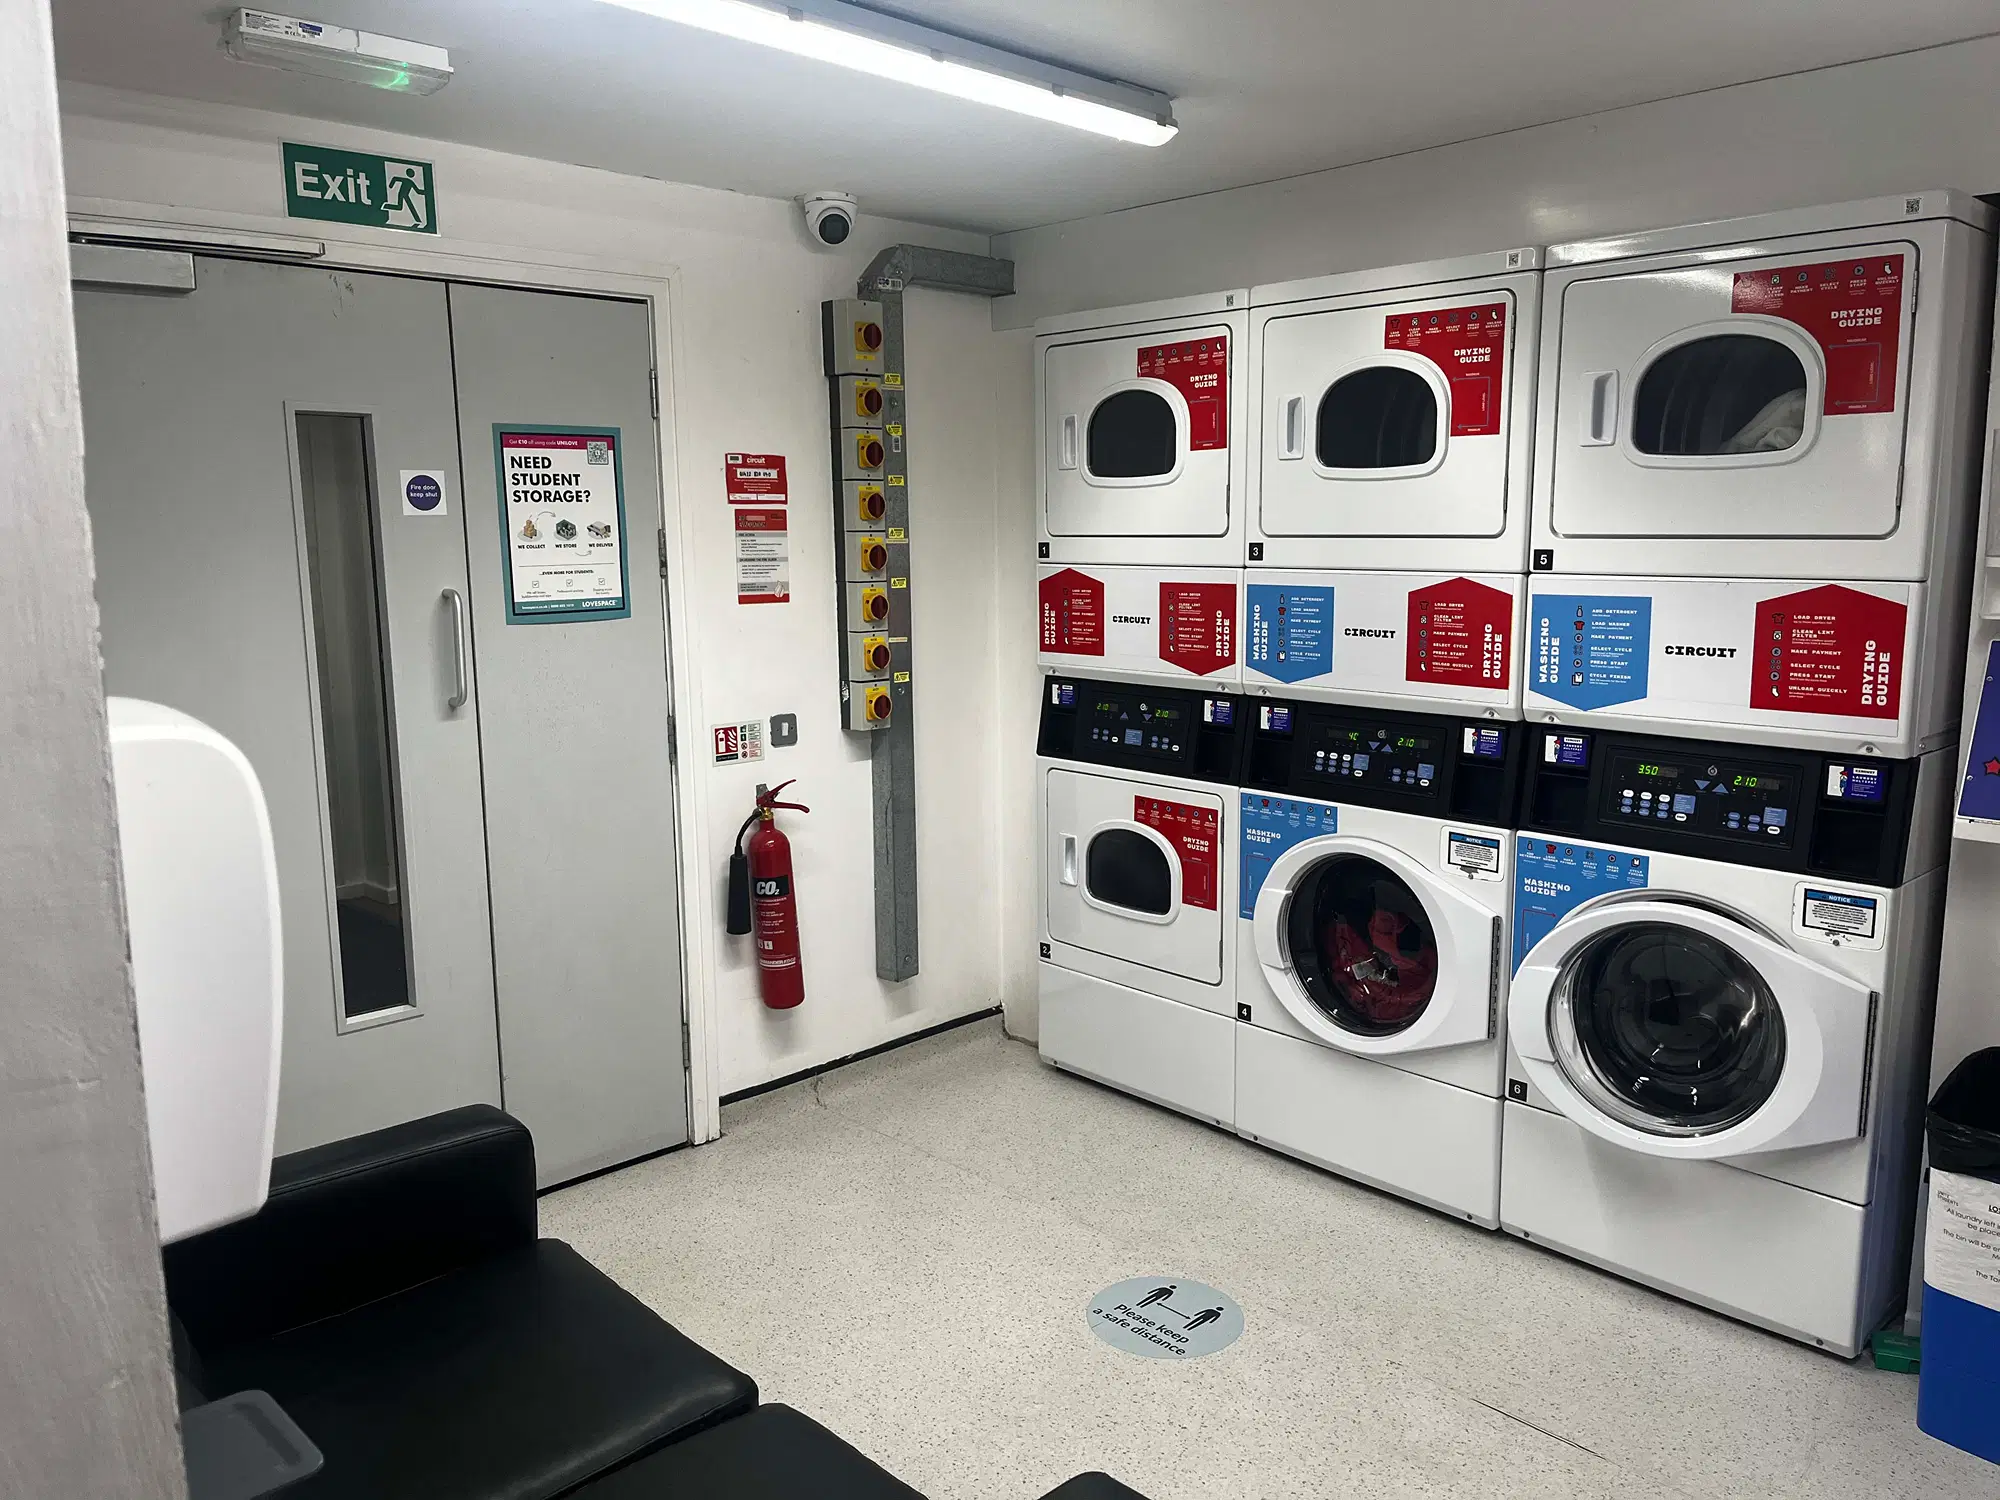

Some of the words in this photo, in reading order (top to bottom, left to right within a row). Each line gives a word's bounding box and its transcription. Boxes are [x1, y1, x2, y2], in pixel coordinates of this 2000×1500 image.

[295, 161, 371, 205] Exit
[1830, 307, 1883, 319] DRYING
[1838, 316, 1882, 328] GUIDE
[1454, 347, 1491, 356] DRYING
[1460, 354, 1491, 364] GUIDE
[1190, 374, 1218, 382] DRYING
[510, 456, 552, 469] NEED
[746, 456, 766, 464] circuit
[512, 473, 580, 486] STUDENT
[513, 489, 591, 503] STORAGE?
[1042, 546, 1046, 555] 1
[1253, 547, 1258, 556] 3
[1540, 555, 1547, 565] 5
[582, 600, 616, 608] LOVESPACE
[1112, 615, 1151, 625] CIRCUIT
[1344, 627, 1396, 639] CIRCUIT
[1483, 624, 1492, 678] DRYING
[1493, 633, 1502, 678] GUIDE
[1539, 618, 1550, 683] WASHING
[1664, 645, 1737, 659] CIRCUIT
[1550, 637, 1560, 683] GUIDE
[1861, 640, 1876, 705] DRYING
[1876, 652, 1890, 706] GUIDE
[1734, 776, 1758, 787] 2.10
[1246, 828, 1281, 839] WASHING
[1247, 834, 1271, 844] GUIDE
[1183, 836, 1209, 846] DRYING
[1187, 843, 1209, 853] GUIDE
[1524, 877, 1571, 892] WASHING
[1524, 885, 1557, 897] GUIDE
[1829, 895, 1851, 903] NOTICE
[1043, 946, 1048, 954] 2
[1242, 1008, 1248, 1016] 4
[1514, 1084, 1521, 1094] 6
[1938, 1194, 1959, 1206] STUDENTS
[1955, 1211, 1983, 1224] laundry
[1984, 1219, 1996, 1228] left
[1968, 1222, 1978, 1231] be
[1944, 1228, 1954, 1238] The
[1956, 1233, 1967, 1242] bin
[1968, 1238, 1979, 1246] will
[1976, 1270, 1988, 1279] The
[1114, 1304, 1157, 1328] Please
[1156, 1324, 1190, 1345] keep
[1102, 1312, 1130, 1329] safe
[1130, 1326, 1186, 1356] distance
